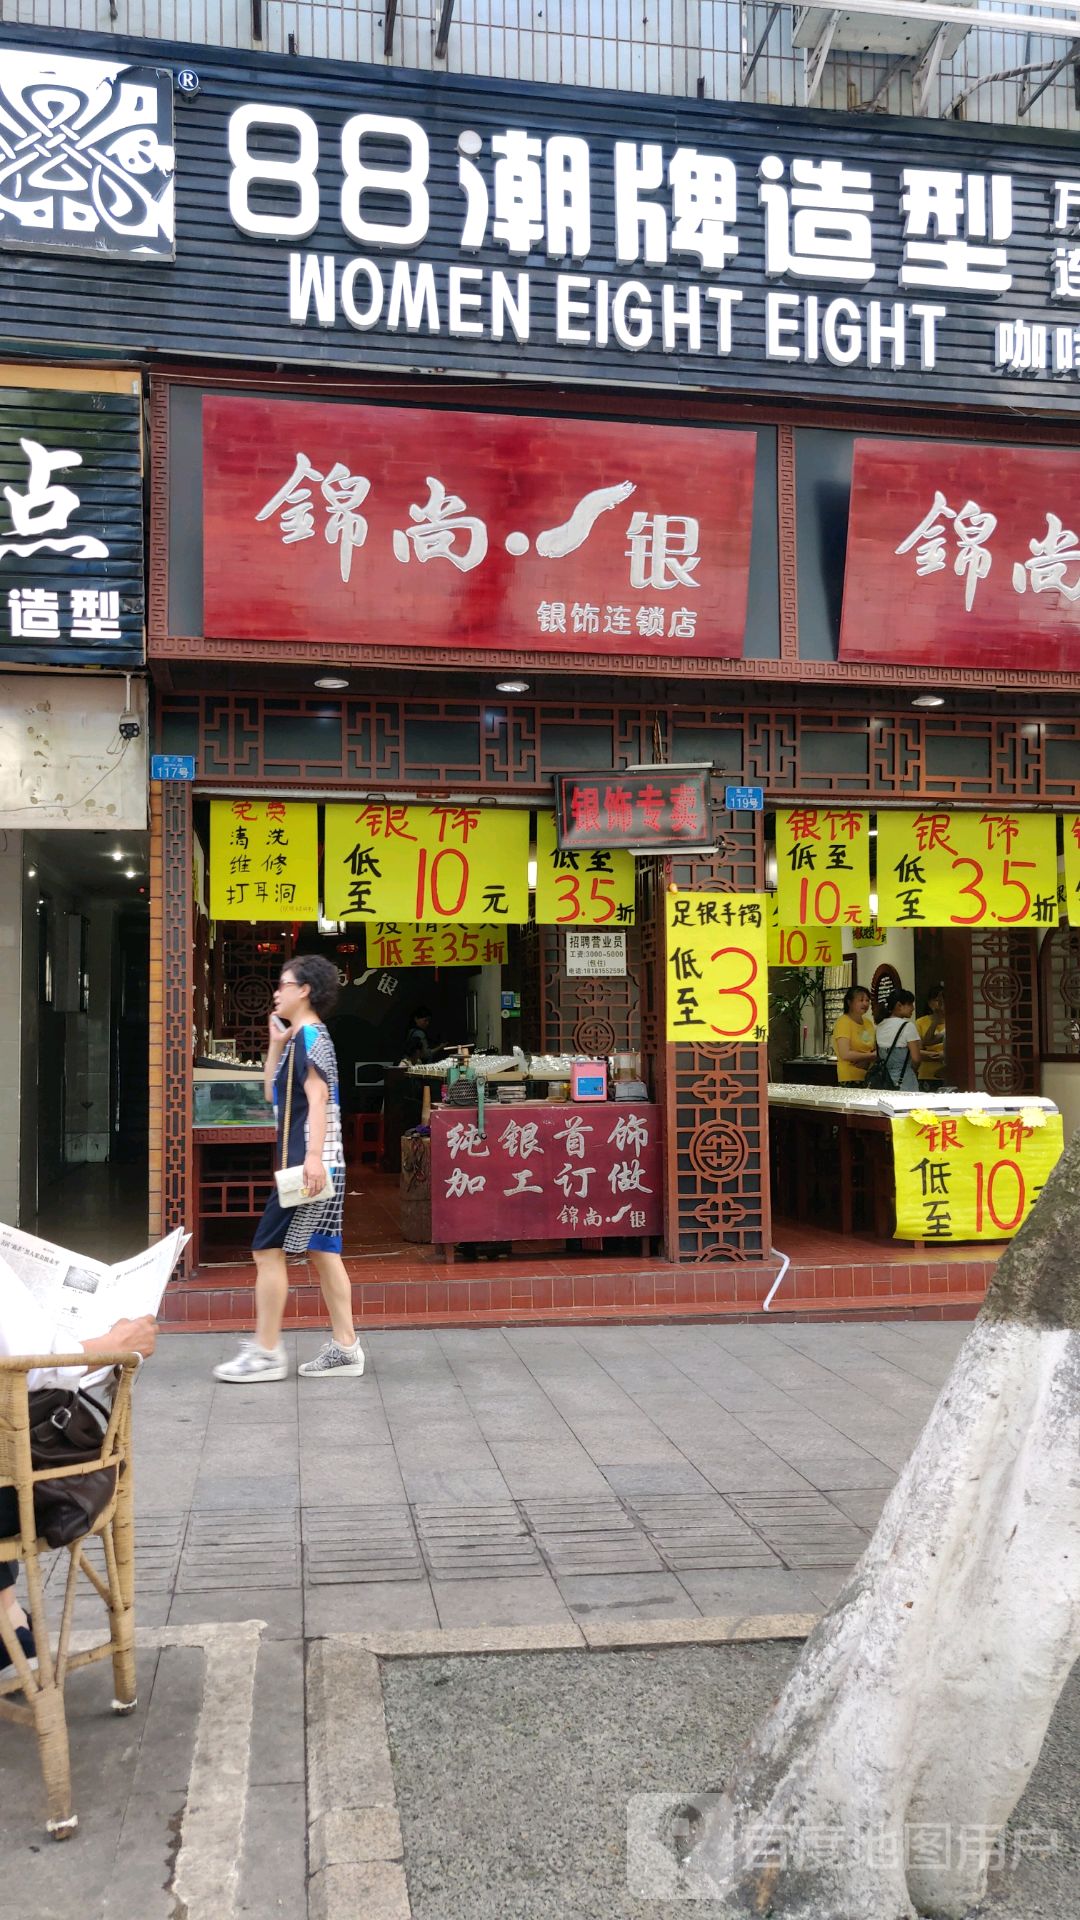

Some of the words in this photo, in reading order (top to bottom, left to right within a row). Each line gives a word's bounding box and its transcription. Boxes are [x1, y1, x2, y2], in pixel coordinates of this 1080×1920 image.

[227, 103, 1013, 292] 88潮牌造型
[288, 252, 530, 343] WOMEN
[556, 275, 743, 356] EIGHT
[765, 292, 946, 371] EIGHT
[8, 588, 122, 639] 造型
[536, 600, 698, 638] 银饰连锁店
[157, 767, 189, 779] 117号
[571, 783, 698, 833] 银饰专卖
[730, 797, 758, 809] 119号
[230, 826, 288, 849] 清洗
[355, 804, 481, 844] 银饰
[786, 808, 863, 841] 银饰
[912, 812, 1019, 856] 银饰
[230, 854, 287, 875] 维修
[549, 848, 614, 873] 低至
[787, 843, 853, 871] 低至
[226, 882, 296, 905] 打耳洞
[340, 843, 382, 917] 低至
[894, 854, 927, 922] 低至
[671, 900, 762, 929] 足银手镯
[799, 877, 863, 925] 10元
[569, 935, 623, 949] 招聘营业员
[669, 947, 706, 1026] 低至
[916, 1119, 1034, 1153] 银饰
[444, 1159, 654, 1199] 加工订做
[910, 1157, 953, 1237] 低至
